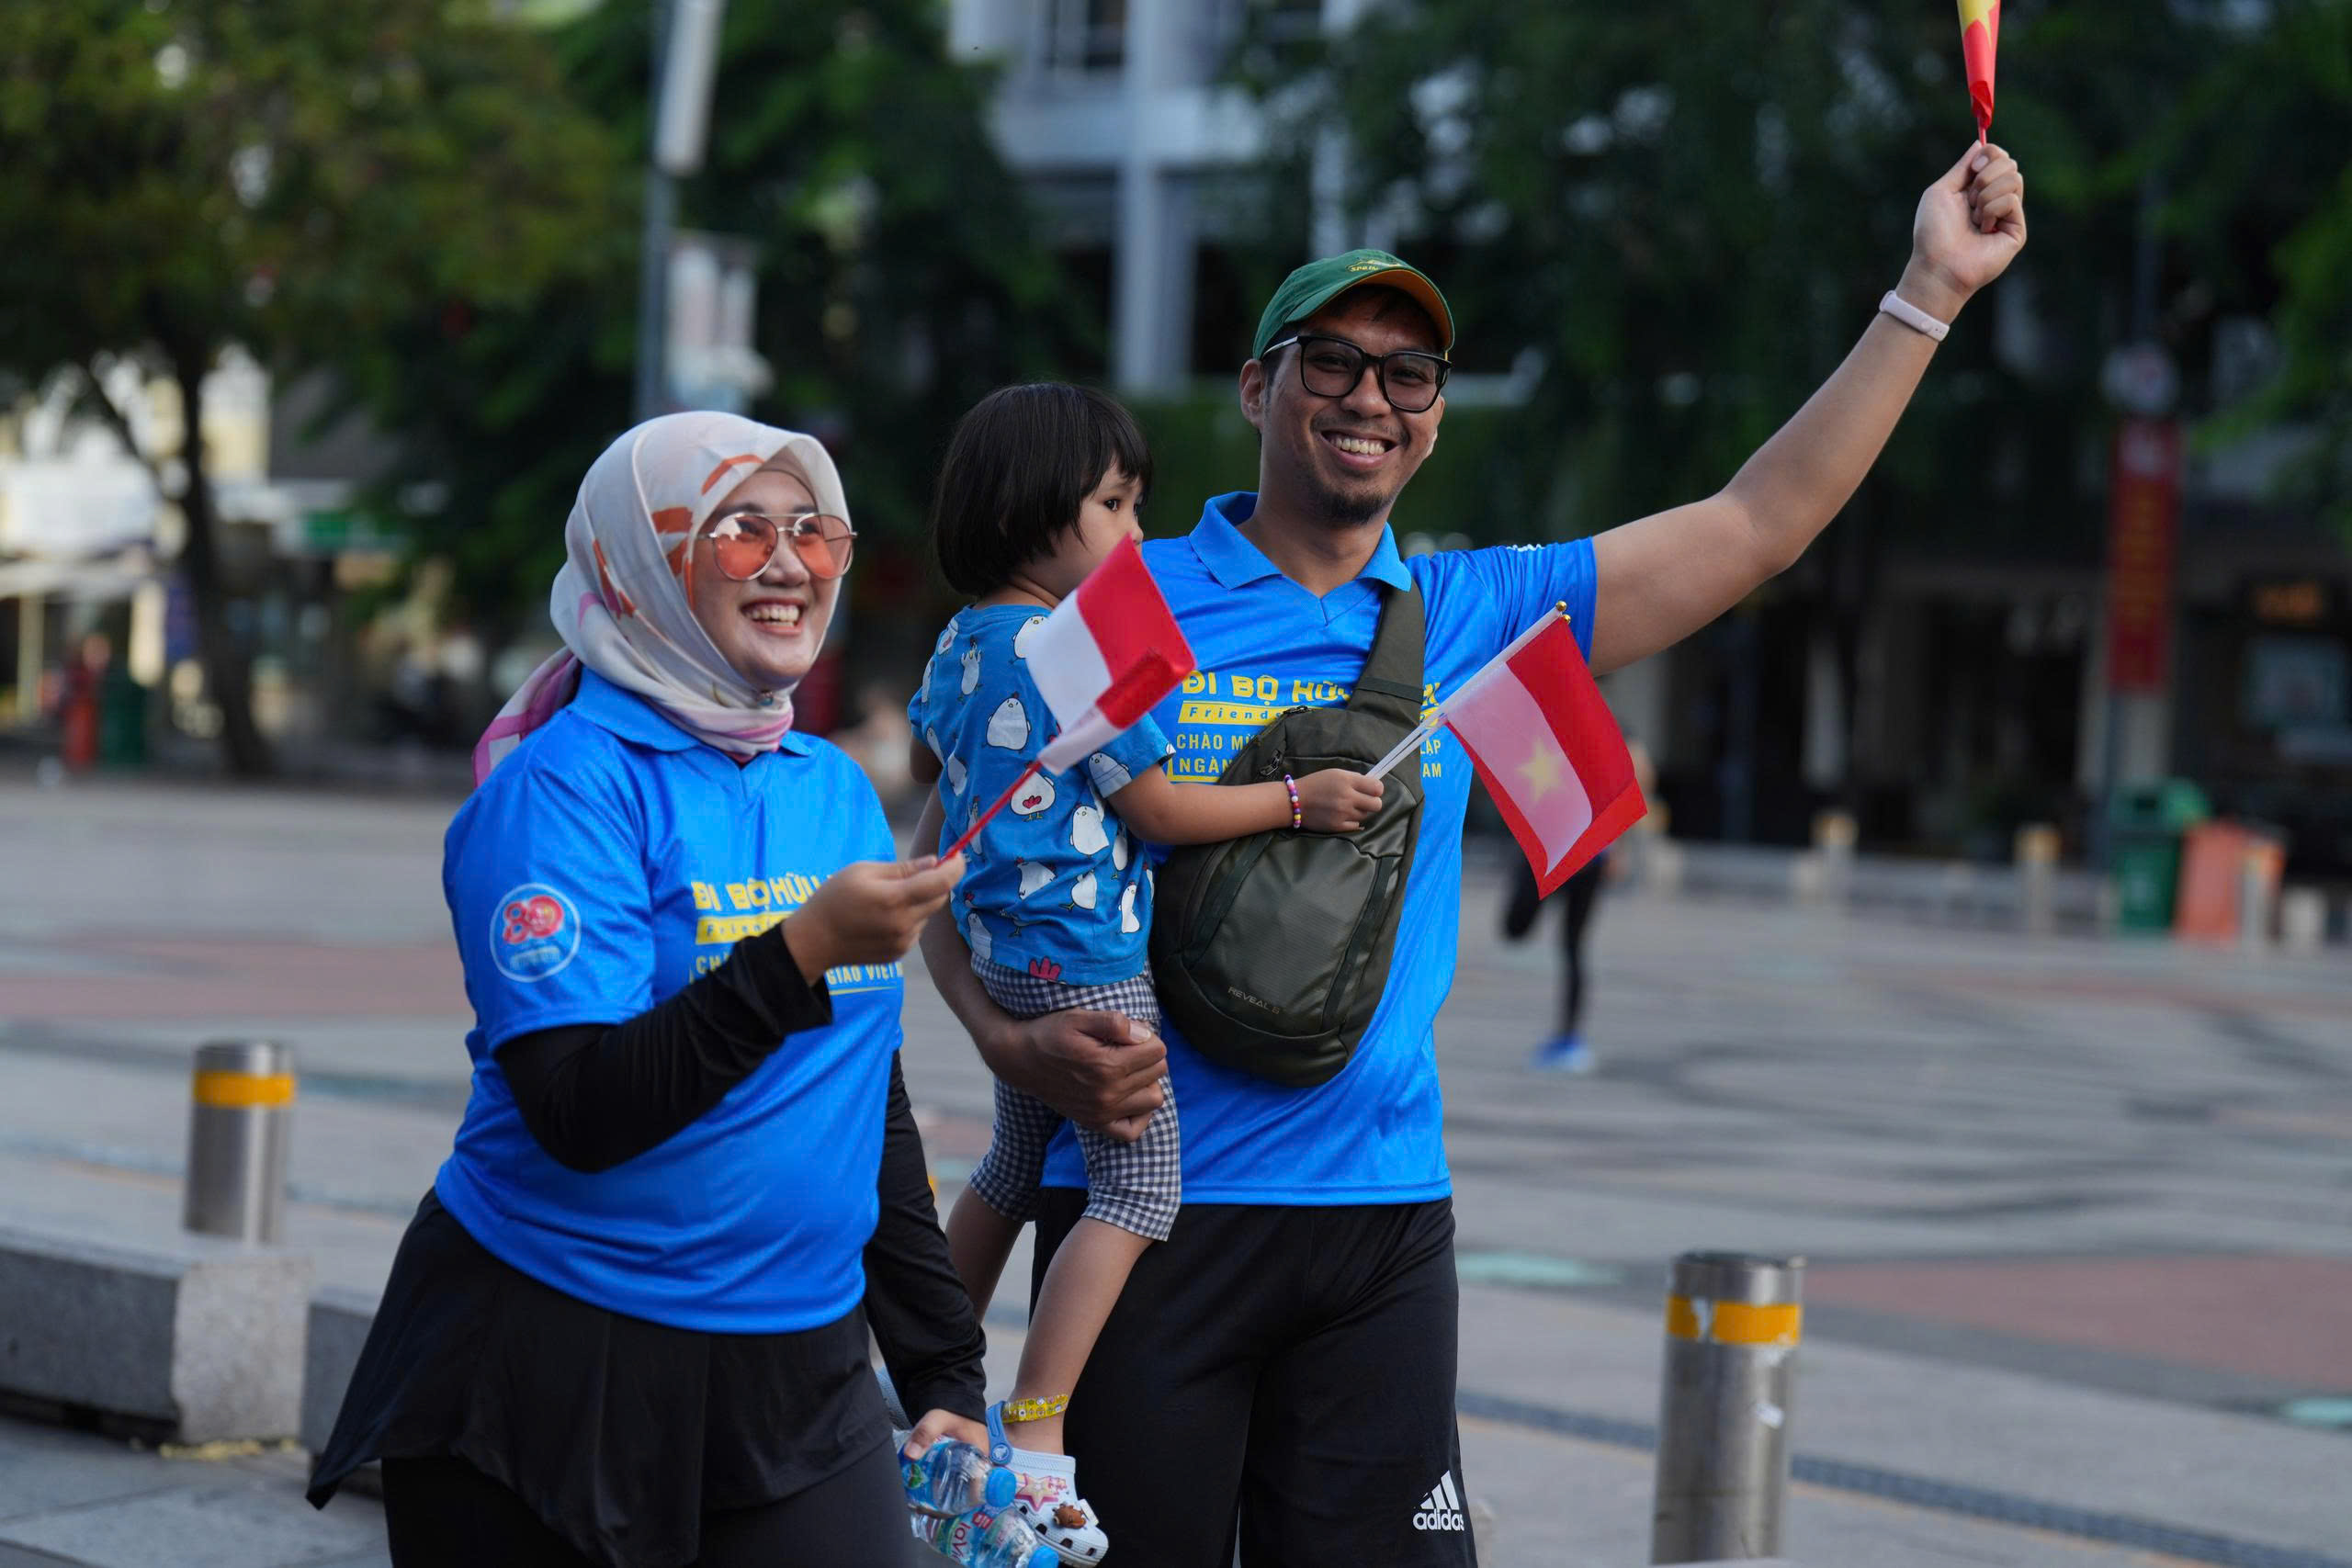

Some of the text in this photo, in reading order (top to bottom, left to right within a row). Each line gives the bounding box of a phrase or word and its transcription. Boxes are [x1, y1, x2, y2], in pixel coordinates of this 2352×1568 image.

[1182, 671, 1216, 695] ĐI
[1231, 674, 1279, 706] BỘ
[1176, 731, 1223, 750] CHÀO
[1412, 1507, 1465, 1531] adidas
